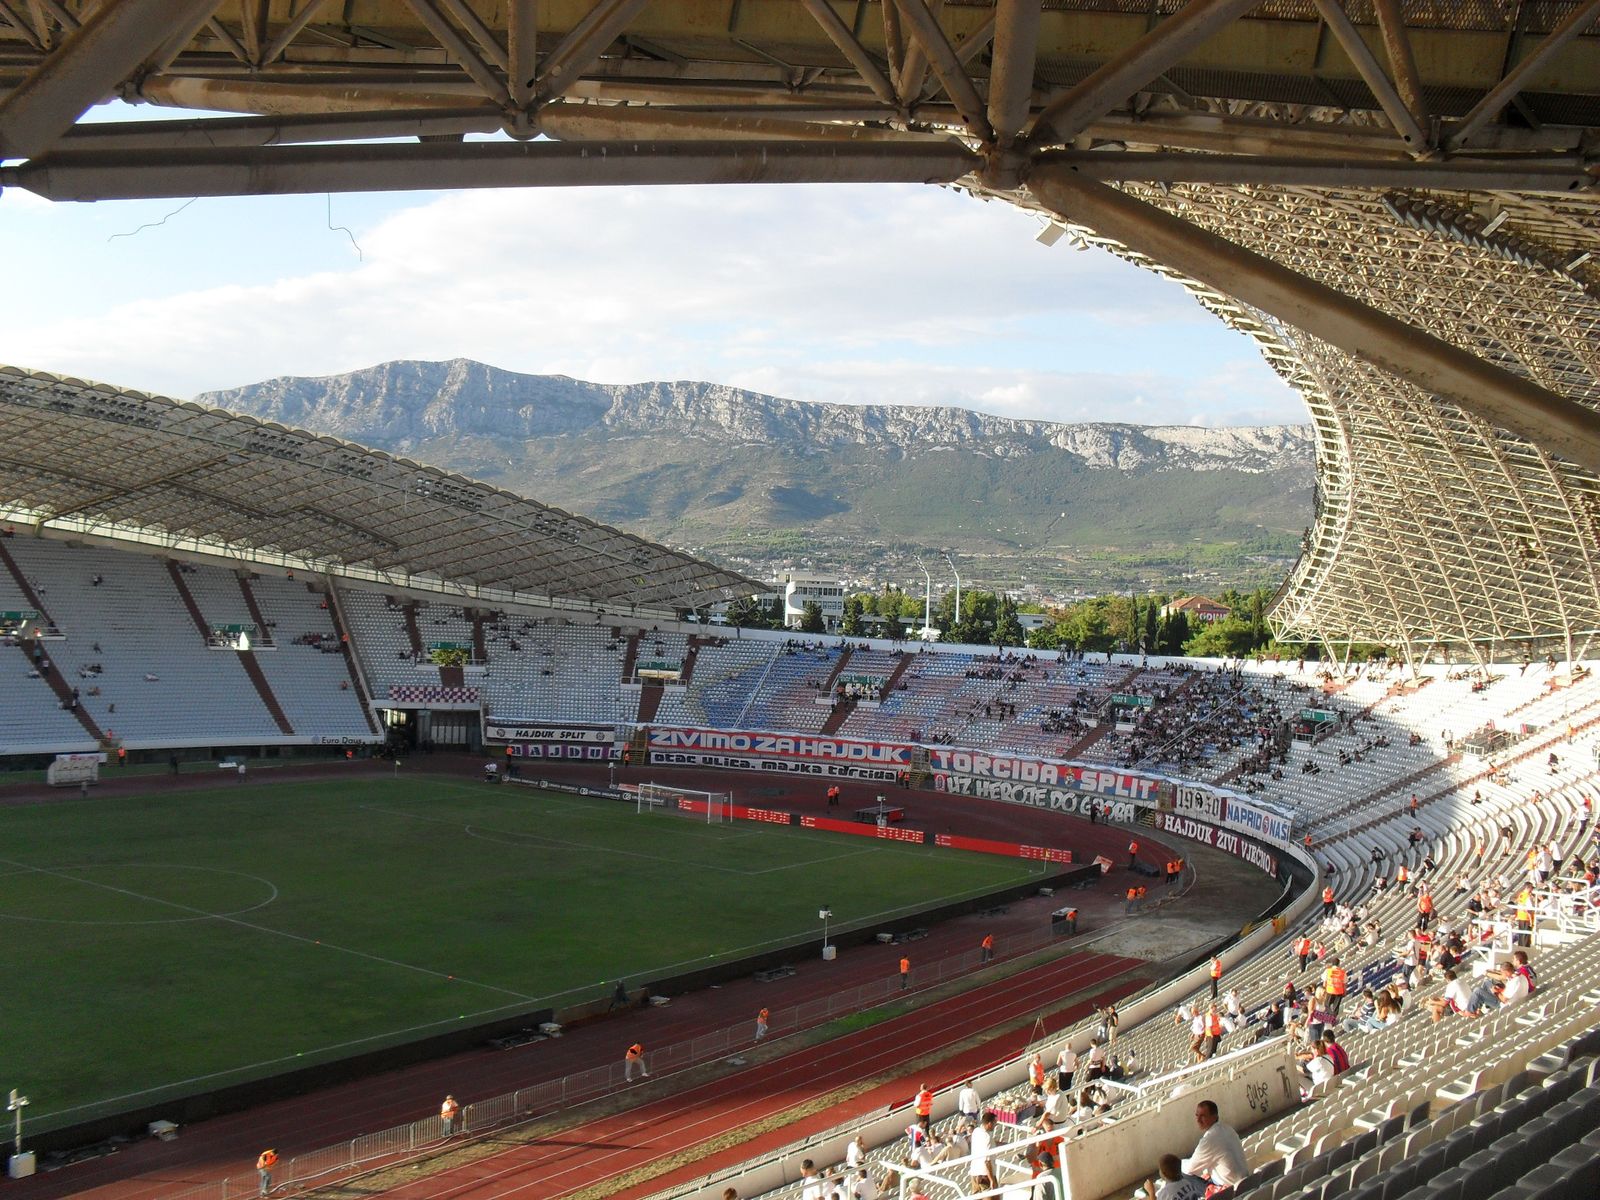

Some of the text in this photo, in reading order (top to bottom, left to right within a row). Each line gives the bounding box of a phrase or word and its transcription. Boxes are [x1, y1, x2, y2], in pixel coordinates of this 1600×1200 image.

[321, 736, 340, 744] Euro
[515, 730, 586, 739] HAJDUK SPLIT
[755, 736, 795, 754] ZA
[799, 740, 906, 763] HAJDUK
[654, 753, 696, 763] otac
[761, 761, 822, 774] majka
[828, 766, 895, 780] torcida
[935, 750, 1155, 799] TORCIDA SPLIT
[947, 776, 972, 795] UZ
[976, 780, 1047, 807] HEROJE
[1050, 791, 1077, 812] DO
[1227, 804, 1263, 831] NAPRID
[1164, 815, 1213, 844] HAJDUK
[1216, 830, 1238, 854] ŽIVI
